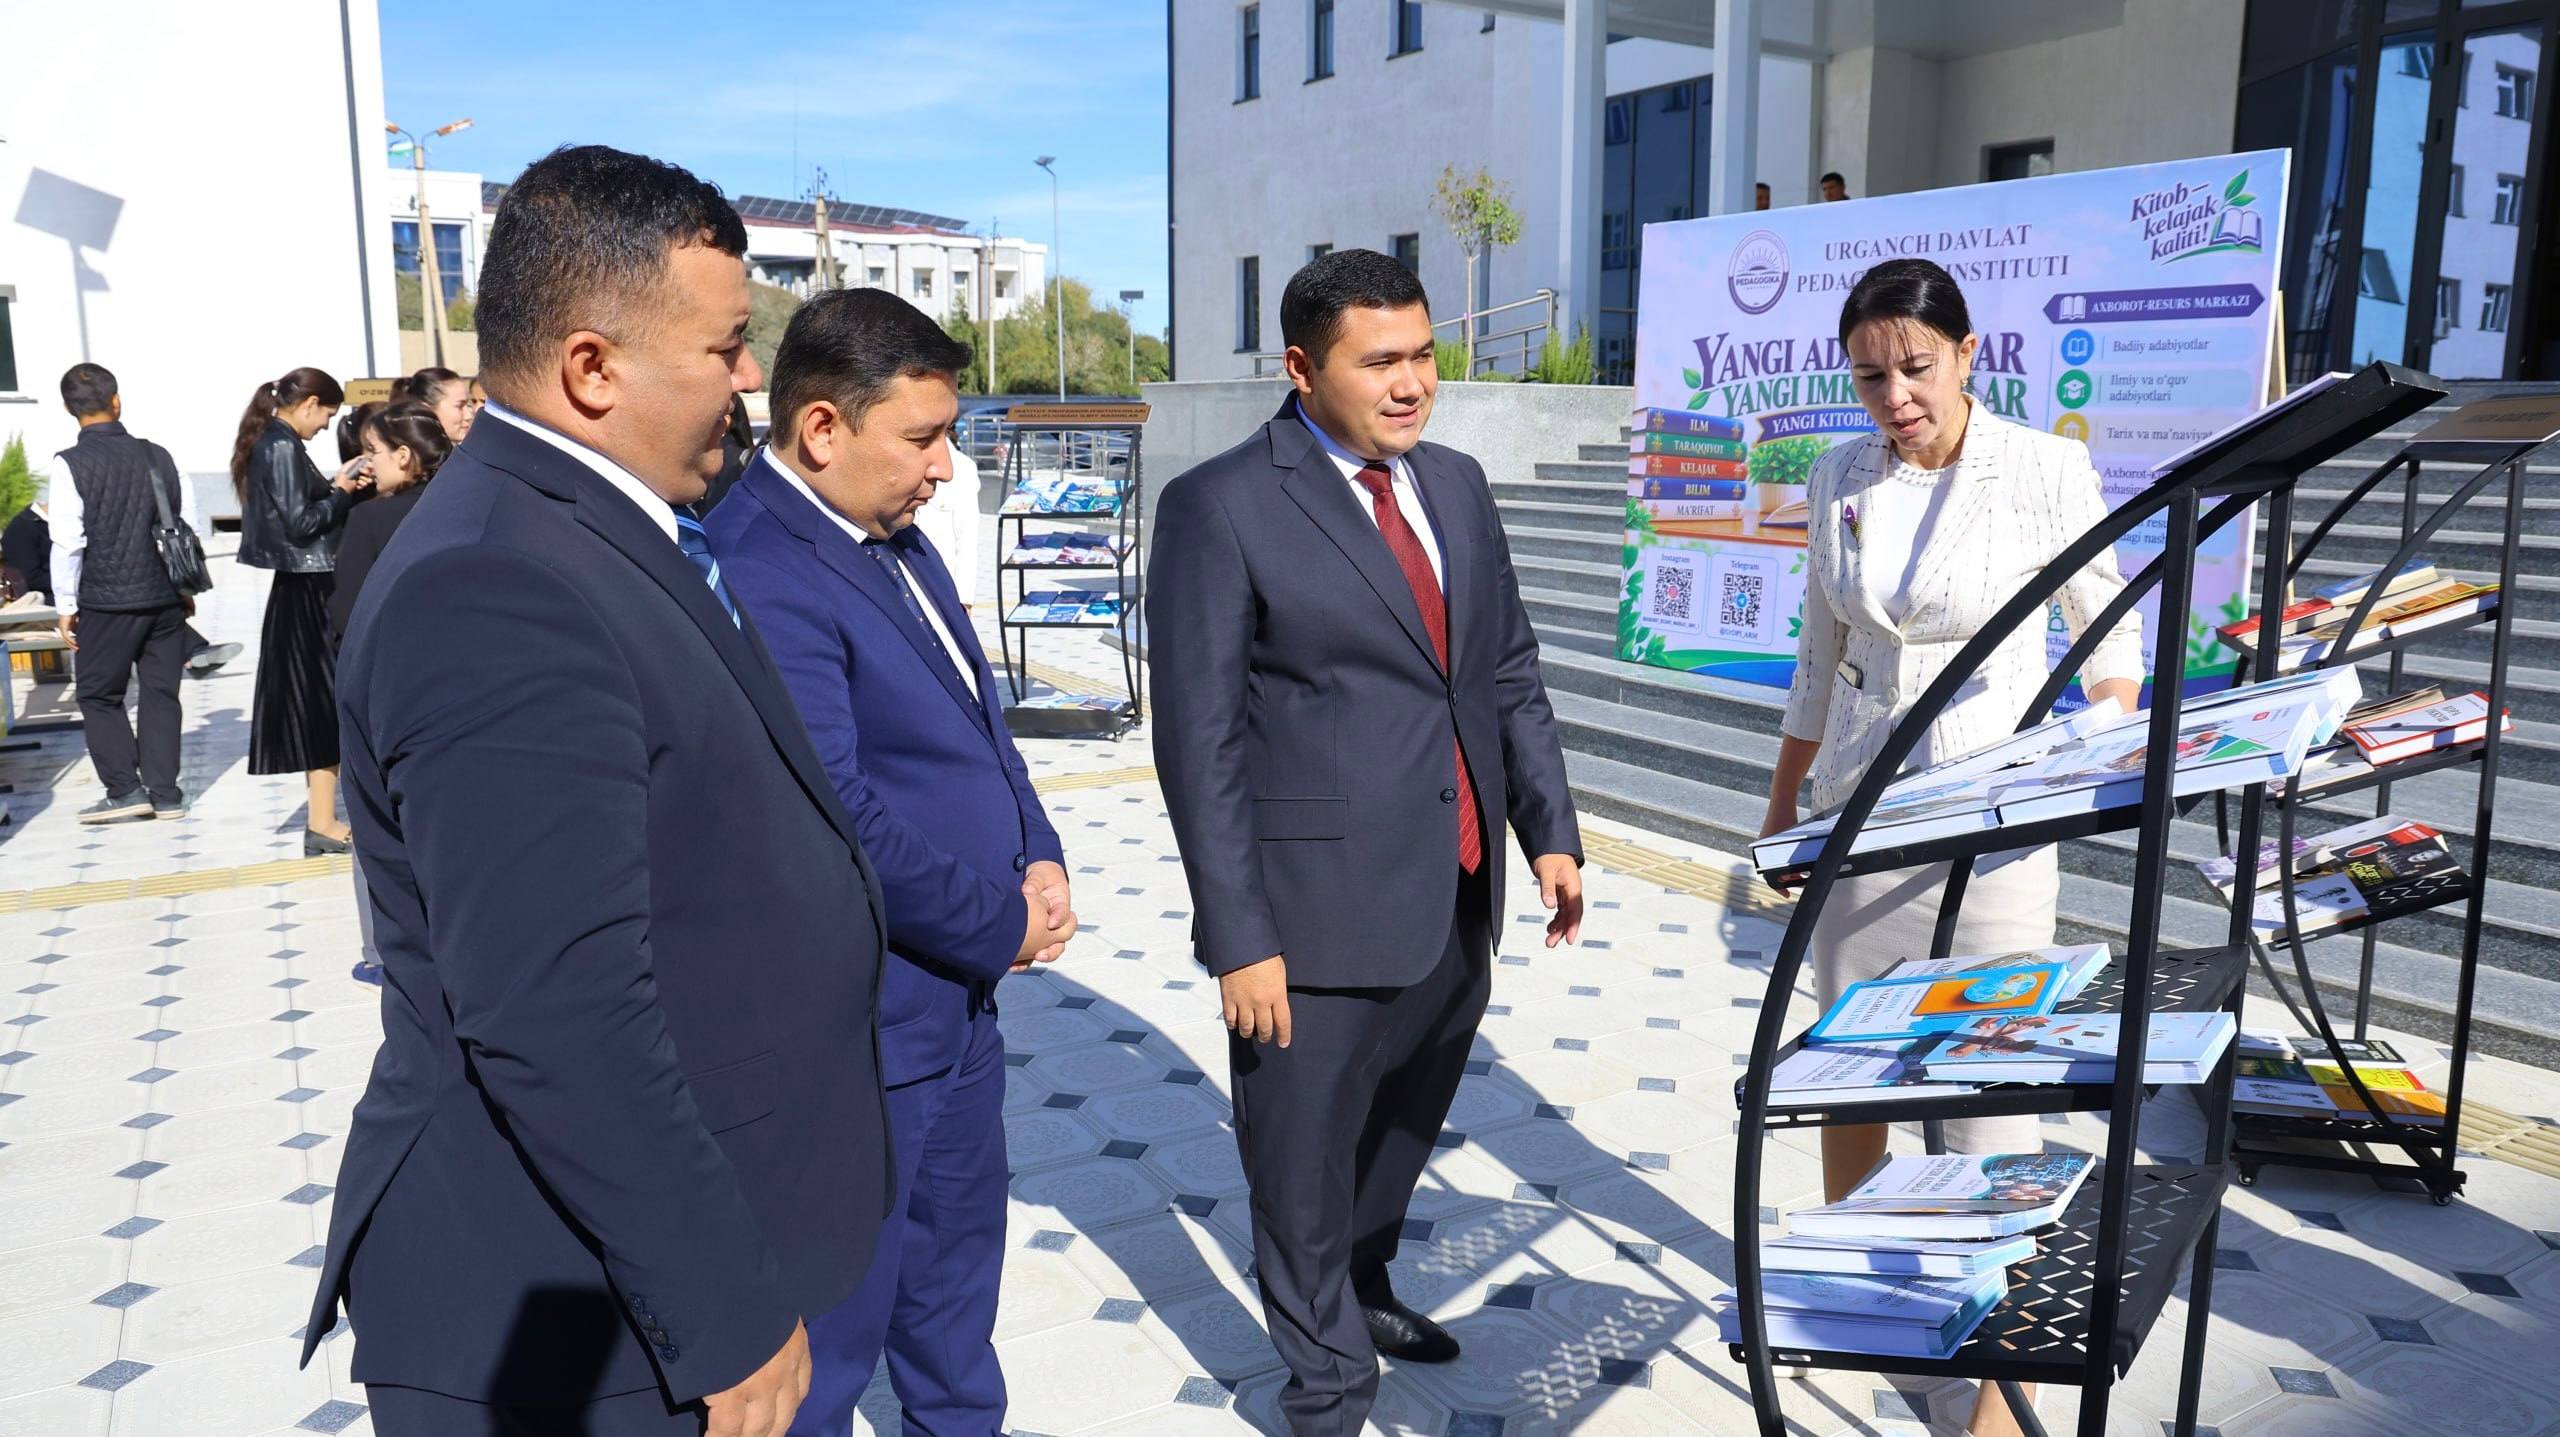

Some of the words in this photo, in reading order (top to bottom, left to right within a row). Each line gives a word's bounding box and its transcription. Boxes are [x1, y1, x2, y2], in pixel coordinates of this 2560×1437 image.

[2130, 182, 2189, 223] Kitob
[2143, 196, 2219, 241] kelajak
[1824, 234, 1931, 262] URGANCH
[1938, 223, 2033, 252] DAVLAT
[2151, 222, 2209, 261] kaliti!
[1735, 276, 1780, 286] PEDAGOGIKA
[2092, 298, 2191, 313] AXBOROT-RESURS
[2194, 294, 2251, 309] MARKAZI
[2148, 338, 2211, 354] adabiyotlar
[1692, 332, 1796, 391] YANGI
[2110, 374, 2139, 389] Ilmiy
[2143, 376, 2154, 386] va
[1721, 375, 1802, 419] YANGI
[2109, 389, 2172, 405] adabiyotlari
[1690, 418, 1710, 433] ILM
[1773, 414, 1816, 434] YANGI
[1818, 411, 1875, 428] KITOBL
[2106, 427, 2134, 440] Tarix
[2137, 430, 2150, 440] va
[1674, 440, 1724, 455] TARAQQIYOT
[1680, 461, 1718, 475] KELAJAK
[1685, 483, 1711, 496] BILIM
